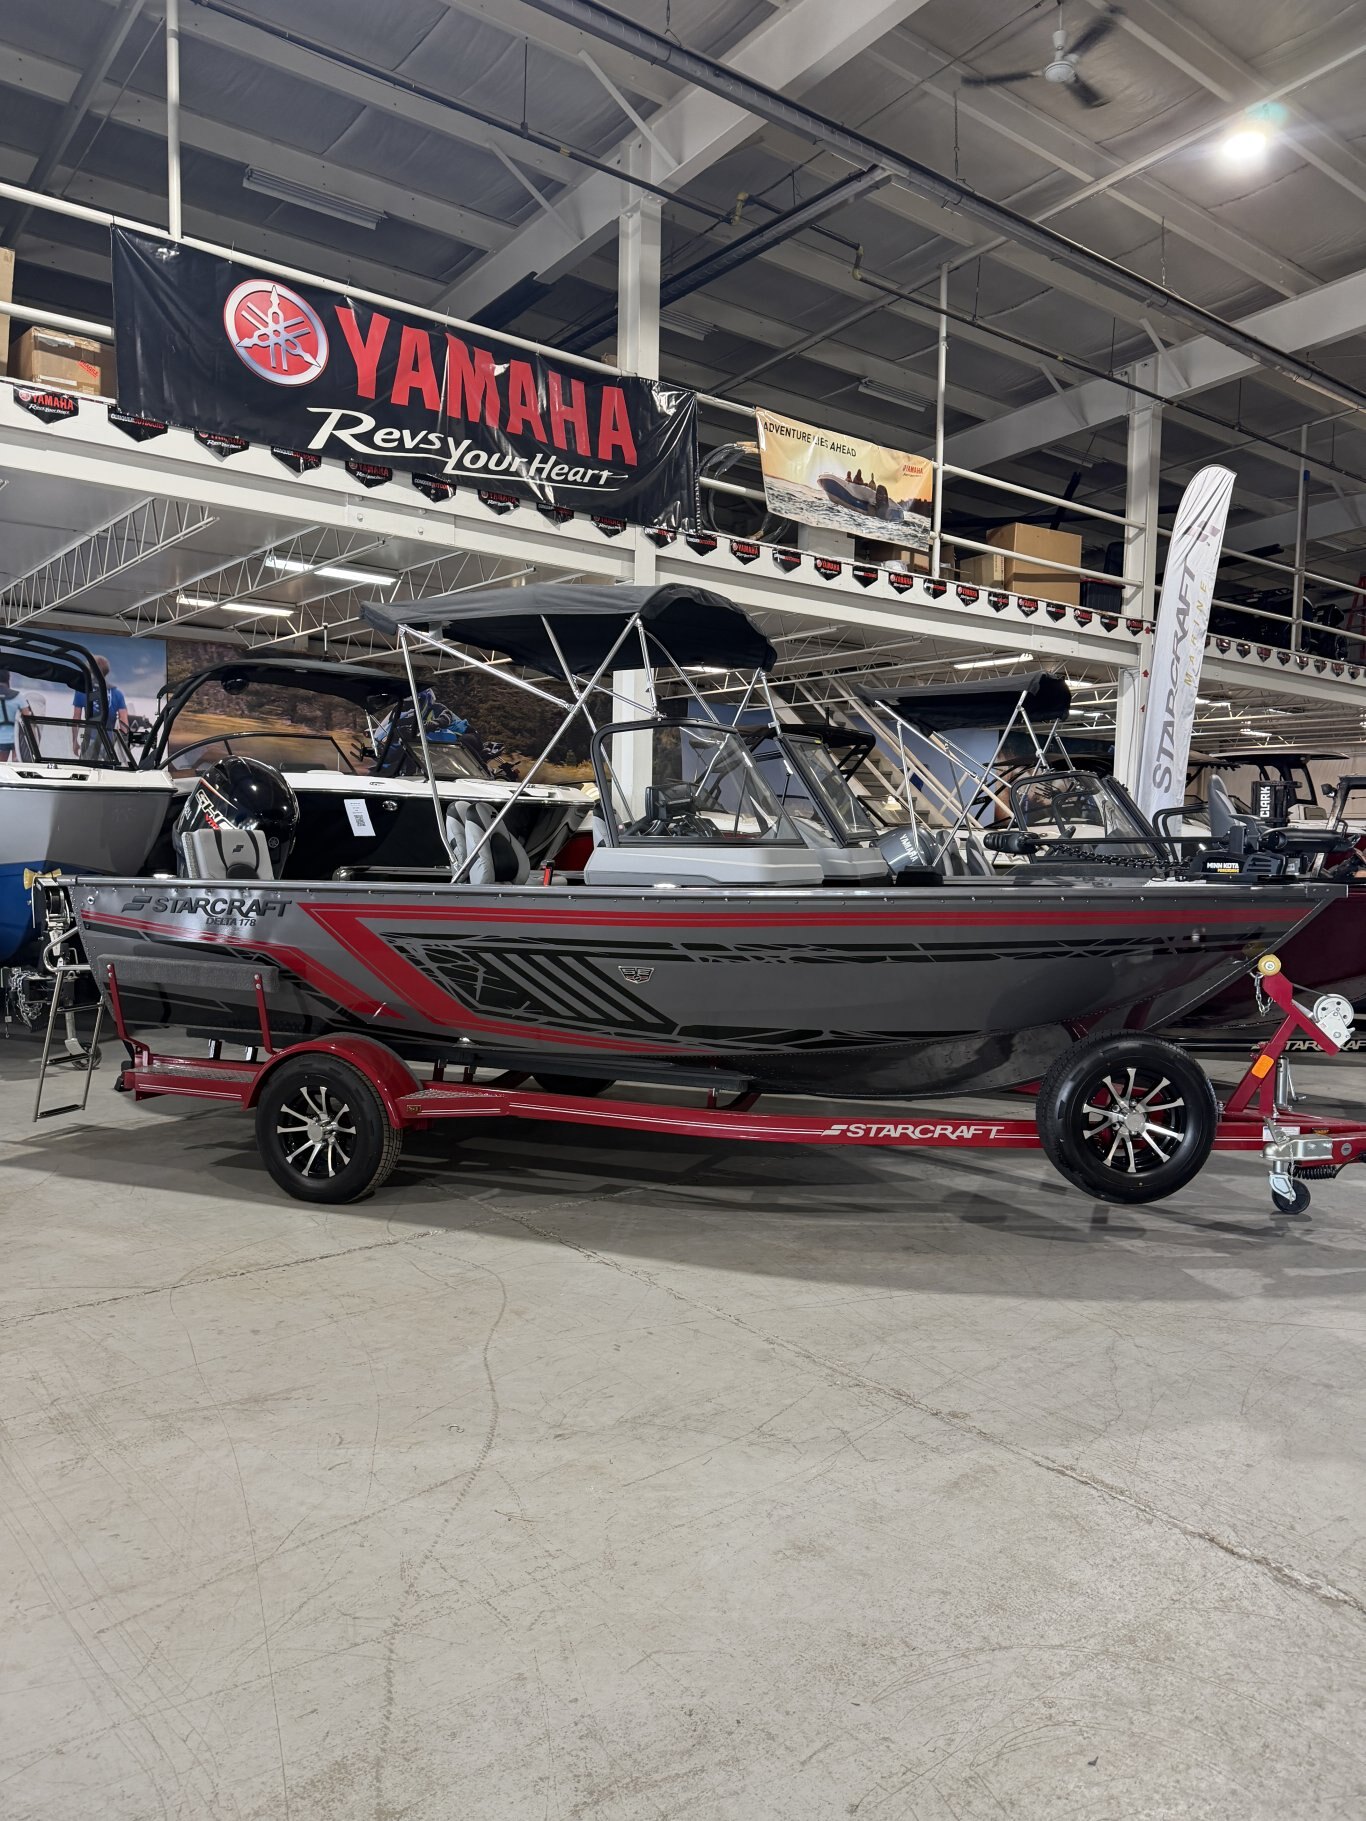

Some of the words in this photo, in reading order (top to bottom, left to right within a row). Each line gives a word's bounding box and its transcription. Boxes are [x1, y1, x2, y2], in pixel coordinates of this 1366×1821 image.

[335, 305, 638, 466] YAMAHA
[32, 395, 74, 410] YAMAHA
[307, 407, 446, 459] Revs
[443, 437, 529, 474] Your
[529, 453, 627, 486] Heart
[763, 422, 812, 443] ADVENTURE
[829, 442, 857, 457] AHEAD
[738, 544, 759, 555] YAMAHA
[1183, 580, 1208, 687] MARINE
[1152, 558, 1196, 794] STARCRAFT
[1259, 786, 1271, 818] CLARK
[900, 834, 919, 862] YAMAHA
[152, 896, 292, 918] STARCRAFT
[205, 916, 237, 926] DELTA
[239, 918, 257, 927] 178
[846, 1123, 1005, 1140] STARCRAFT
